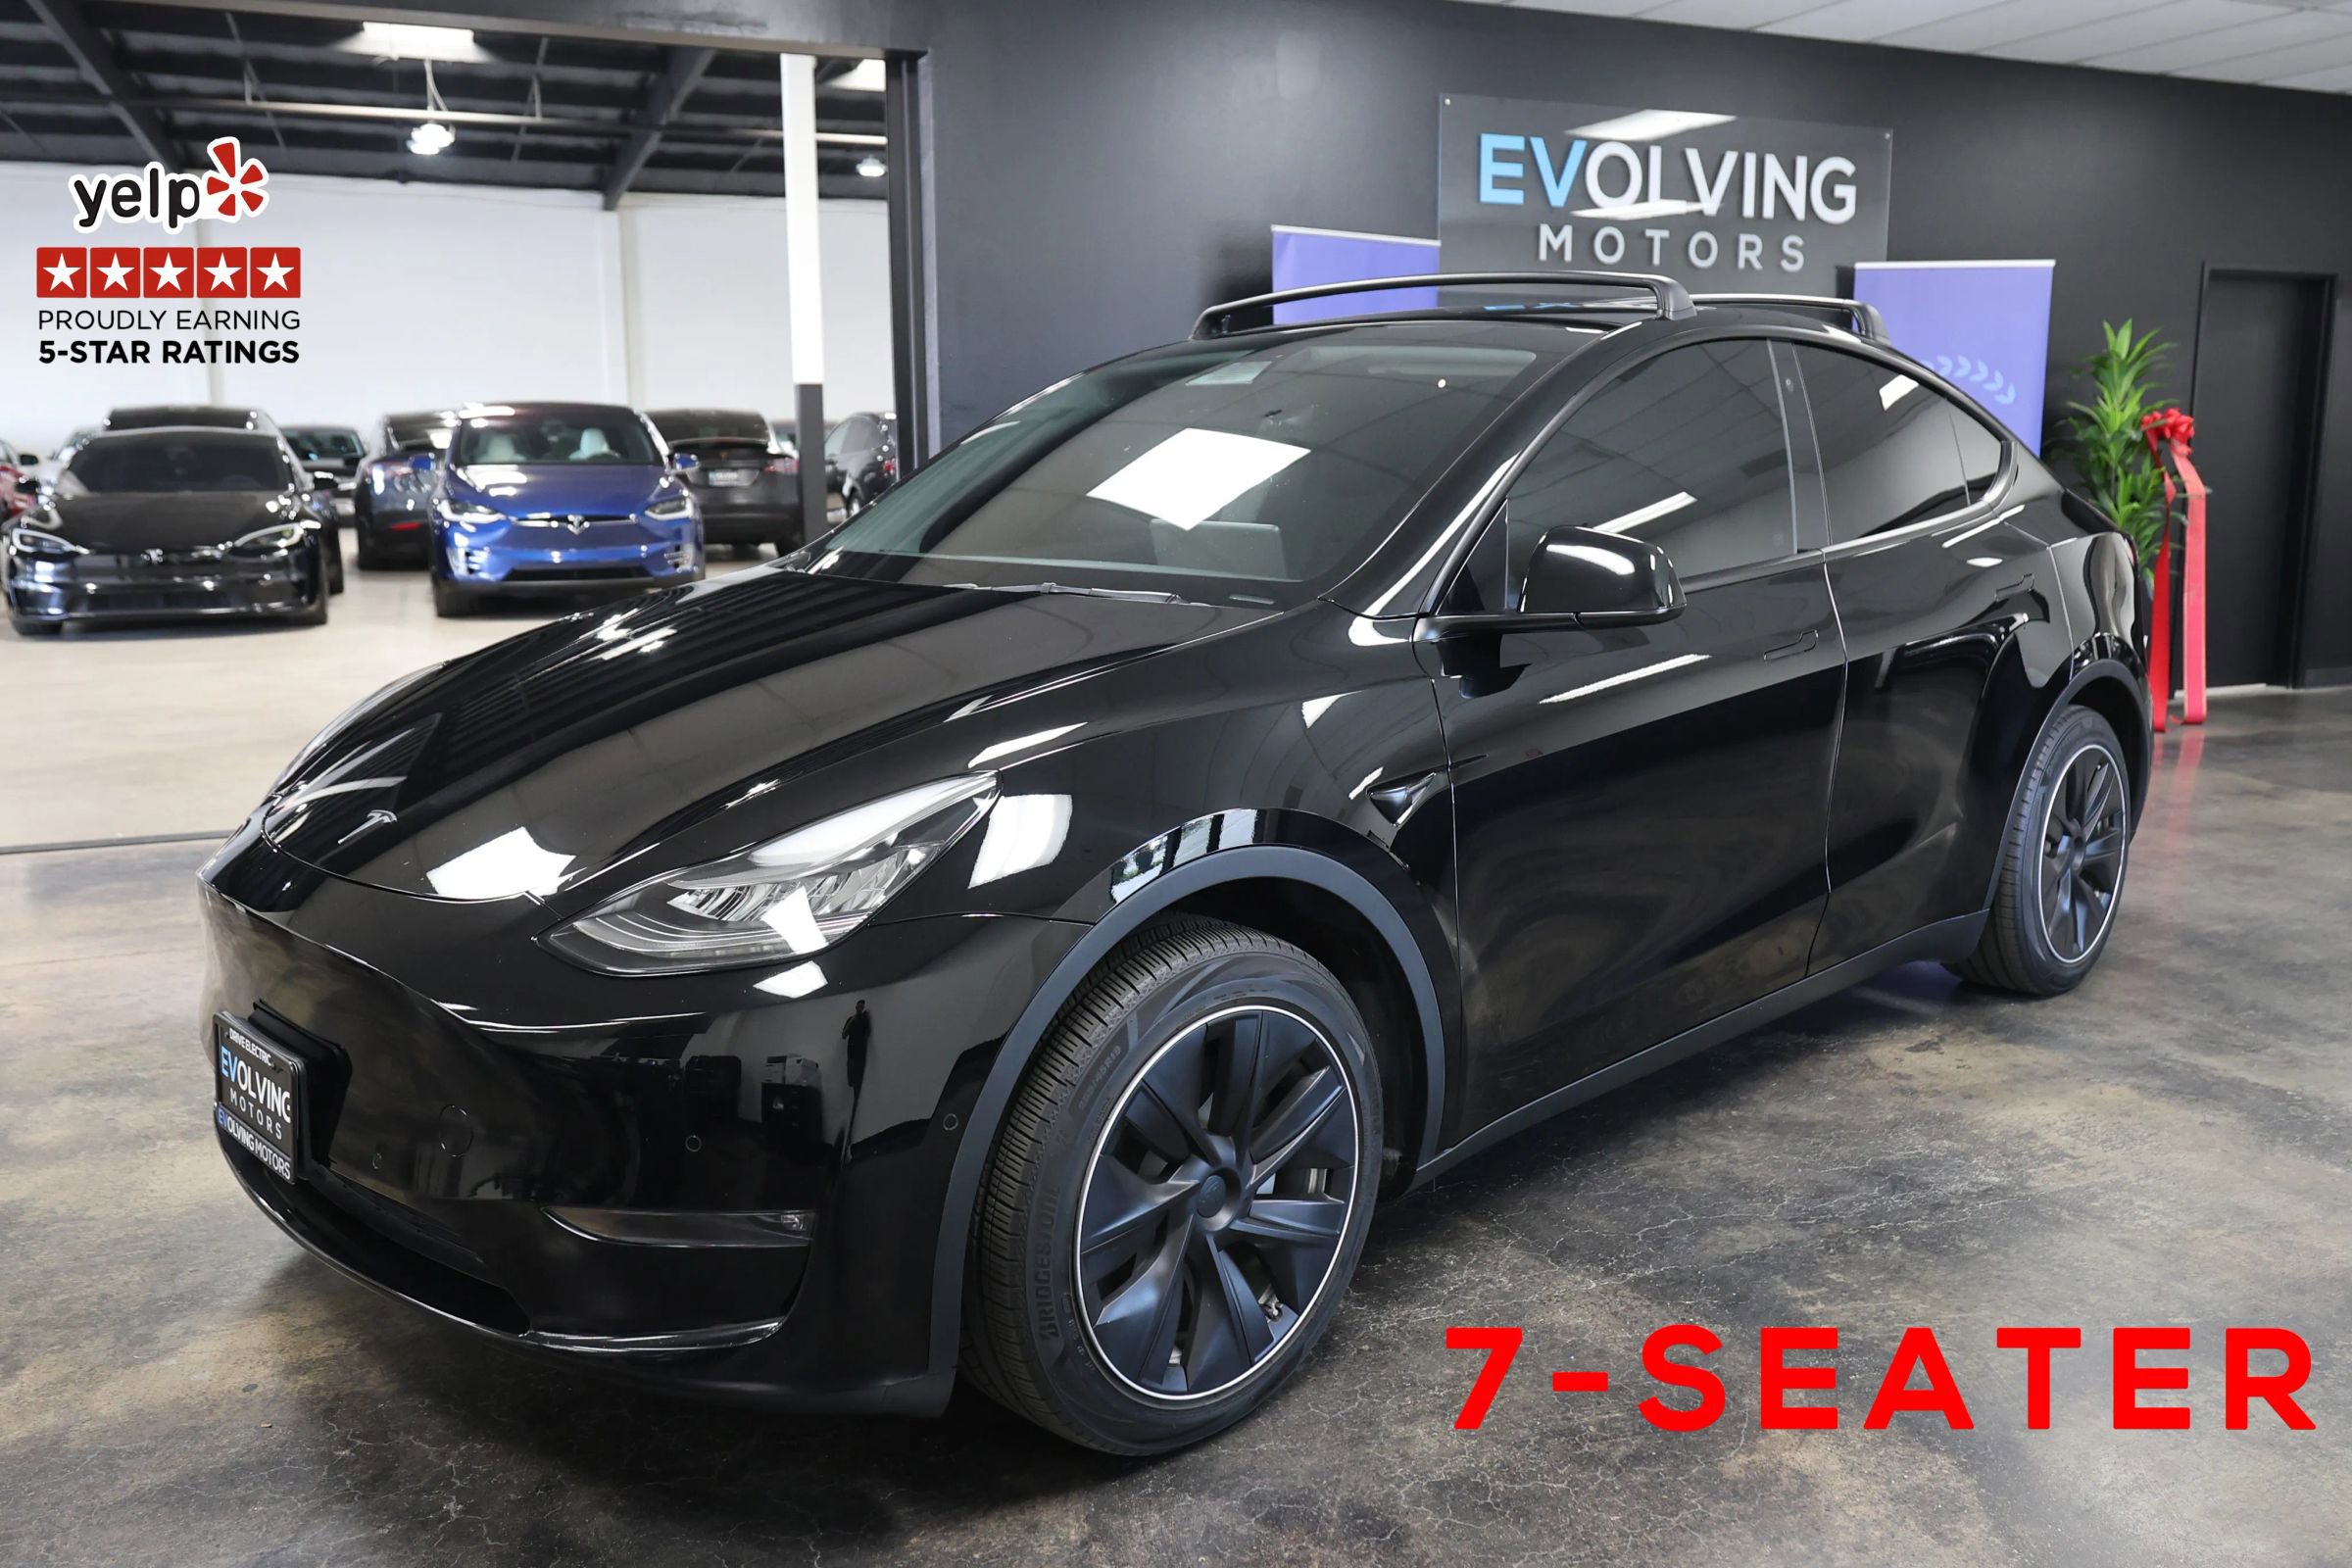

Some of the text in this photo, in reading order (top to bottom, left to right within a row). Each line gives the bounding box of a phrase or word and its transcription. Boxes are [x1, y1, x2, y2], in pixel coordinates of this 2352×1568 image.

[1478, 132, 1857, 225] EVOLVING
[1538, 223, 1805, 272] MOTORS
[228, 1028, 272, 1067] DRIVE ELECTRIC
[220, 1045, 292, 1124] EVOLVING
[229, 1088, 282, 1141] MOTORS
[218, 1107, 291, 1181] EVOLVING MOTORS
